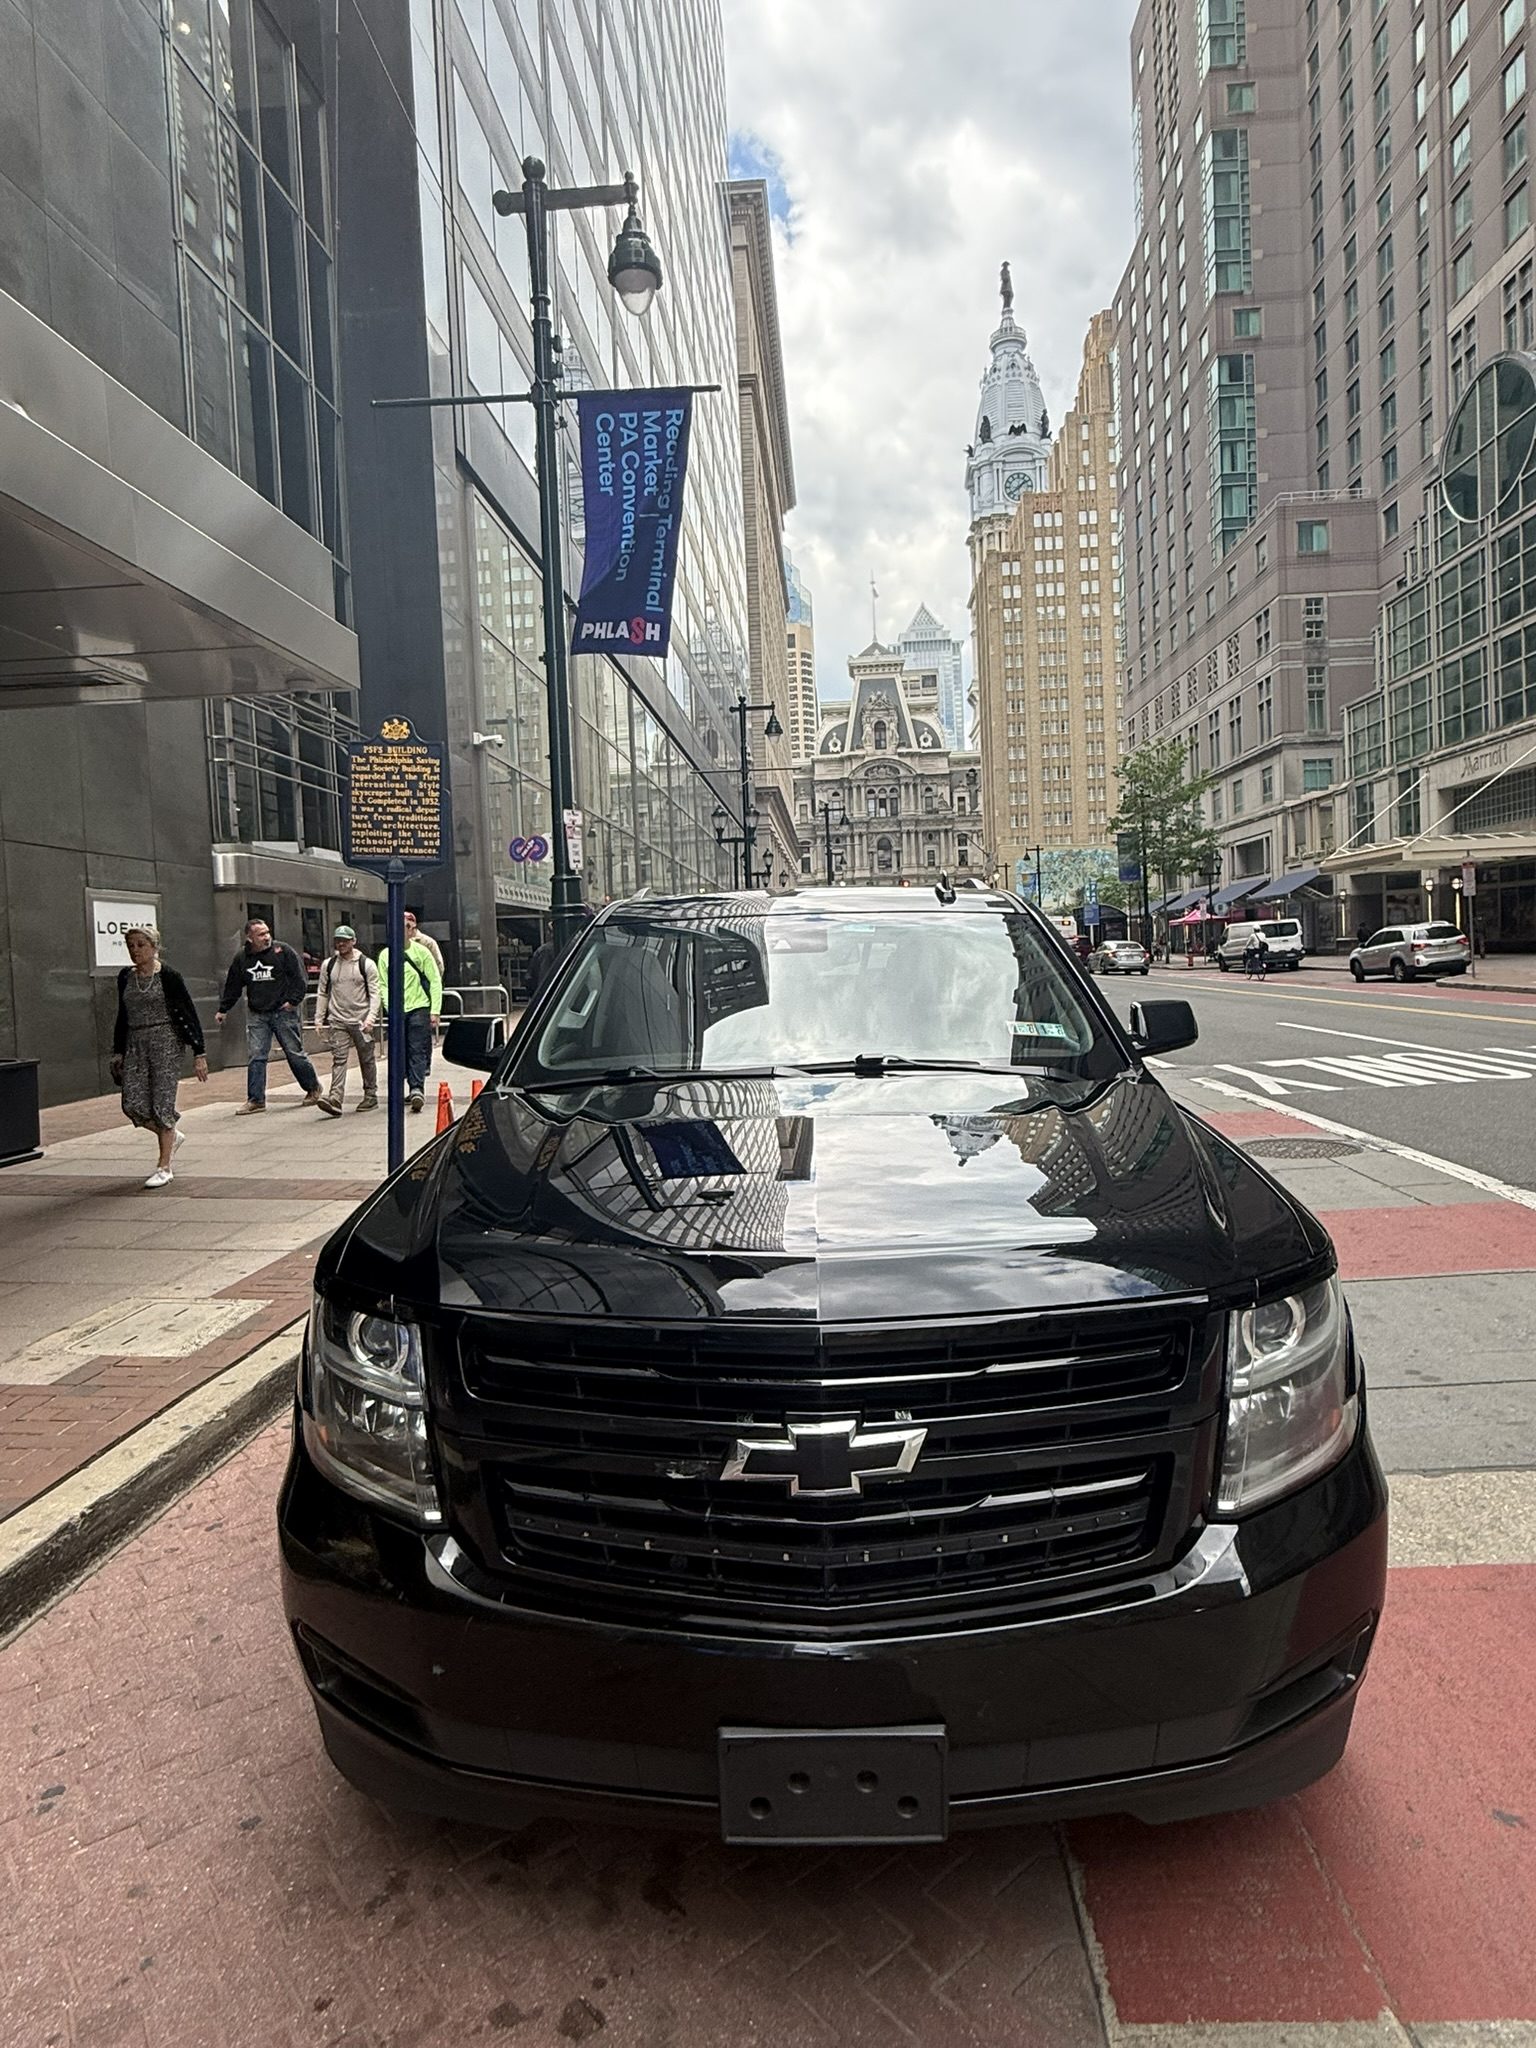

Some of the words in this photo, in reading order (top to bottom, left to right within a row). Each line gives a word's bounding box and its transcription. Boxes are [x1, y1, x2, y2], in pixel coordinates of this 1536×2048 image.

[619, 412, 638, 447] PA
[595, 413, 615, 496] Center
[642, 411, 662, 497] Market
[656, 409, 684, 510] Reading
[616, 454, 640, 582] Convention
[645, 513, 672, 613] Terminal
[581, 617, 660, 644] PHLASH
[363, 746, 383, 754] PSFS
[387, 746, 428, 754] BUILDING
[369, 756, 413, 765] Philadelphia
[416, 757, 440, 766] Saving
[1461, 743, 1508, 777] Marriott
[372, 765, 399, 773] Society
[401, 765, 431, 773] Building
[418, 782, 440, 790] Style
[351, 789, 392, 797] skyscraper
[373, 813, 393, 821] from
[351, 829, 393, 838] exploiting
[352, 838, 414, 846] technological
[97, 921, 153, 934] LOE
